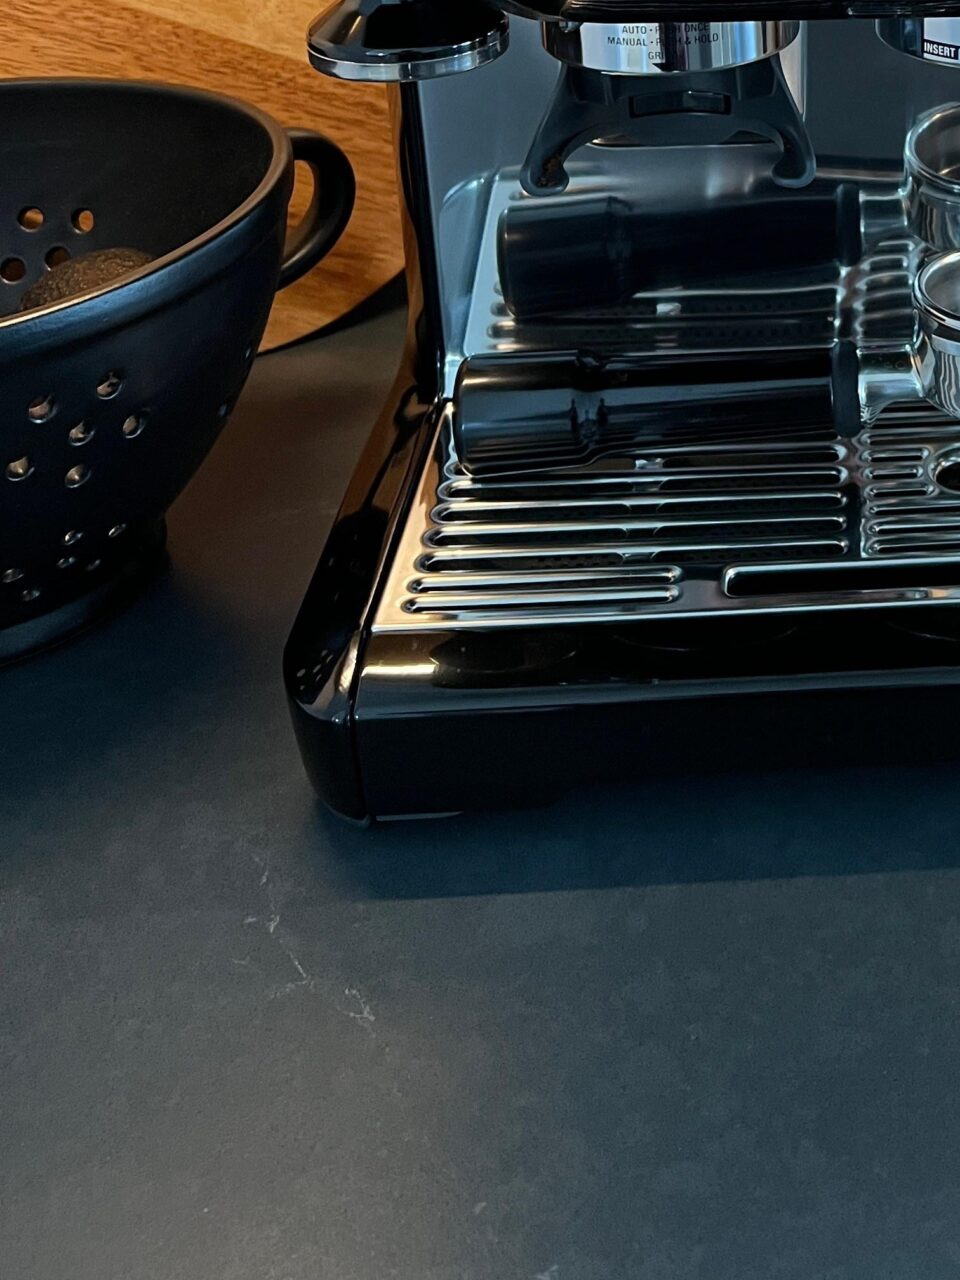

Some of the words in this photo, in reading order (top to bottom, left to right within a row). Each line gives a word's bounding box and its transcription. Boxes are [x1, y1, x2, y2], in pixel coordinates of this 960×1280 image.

[621, 25, 647, 35] AUTO
[684, 23, 710, 33] ONCE
[607, 36, 648, 47] MANUAL
[694, 32, 719, 44] HOLD
[924, 41, 956, 58] INSERT
